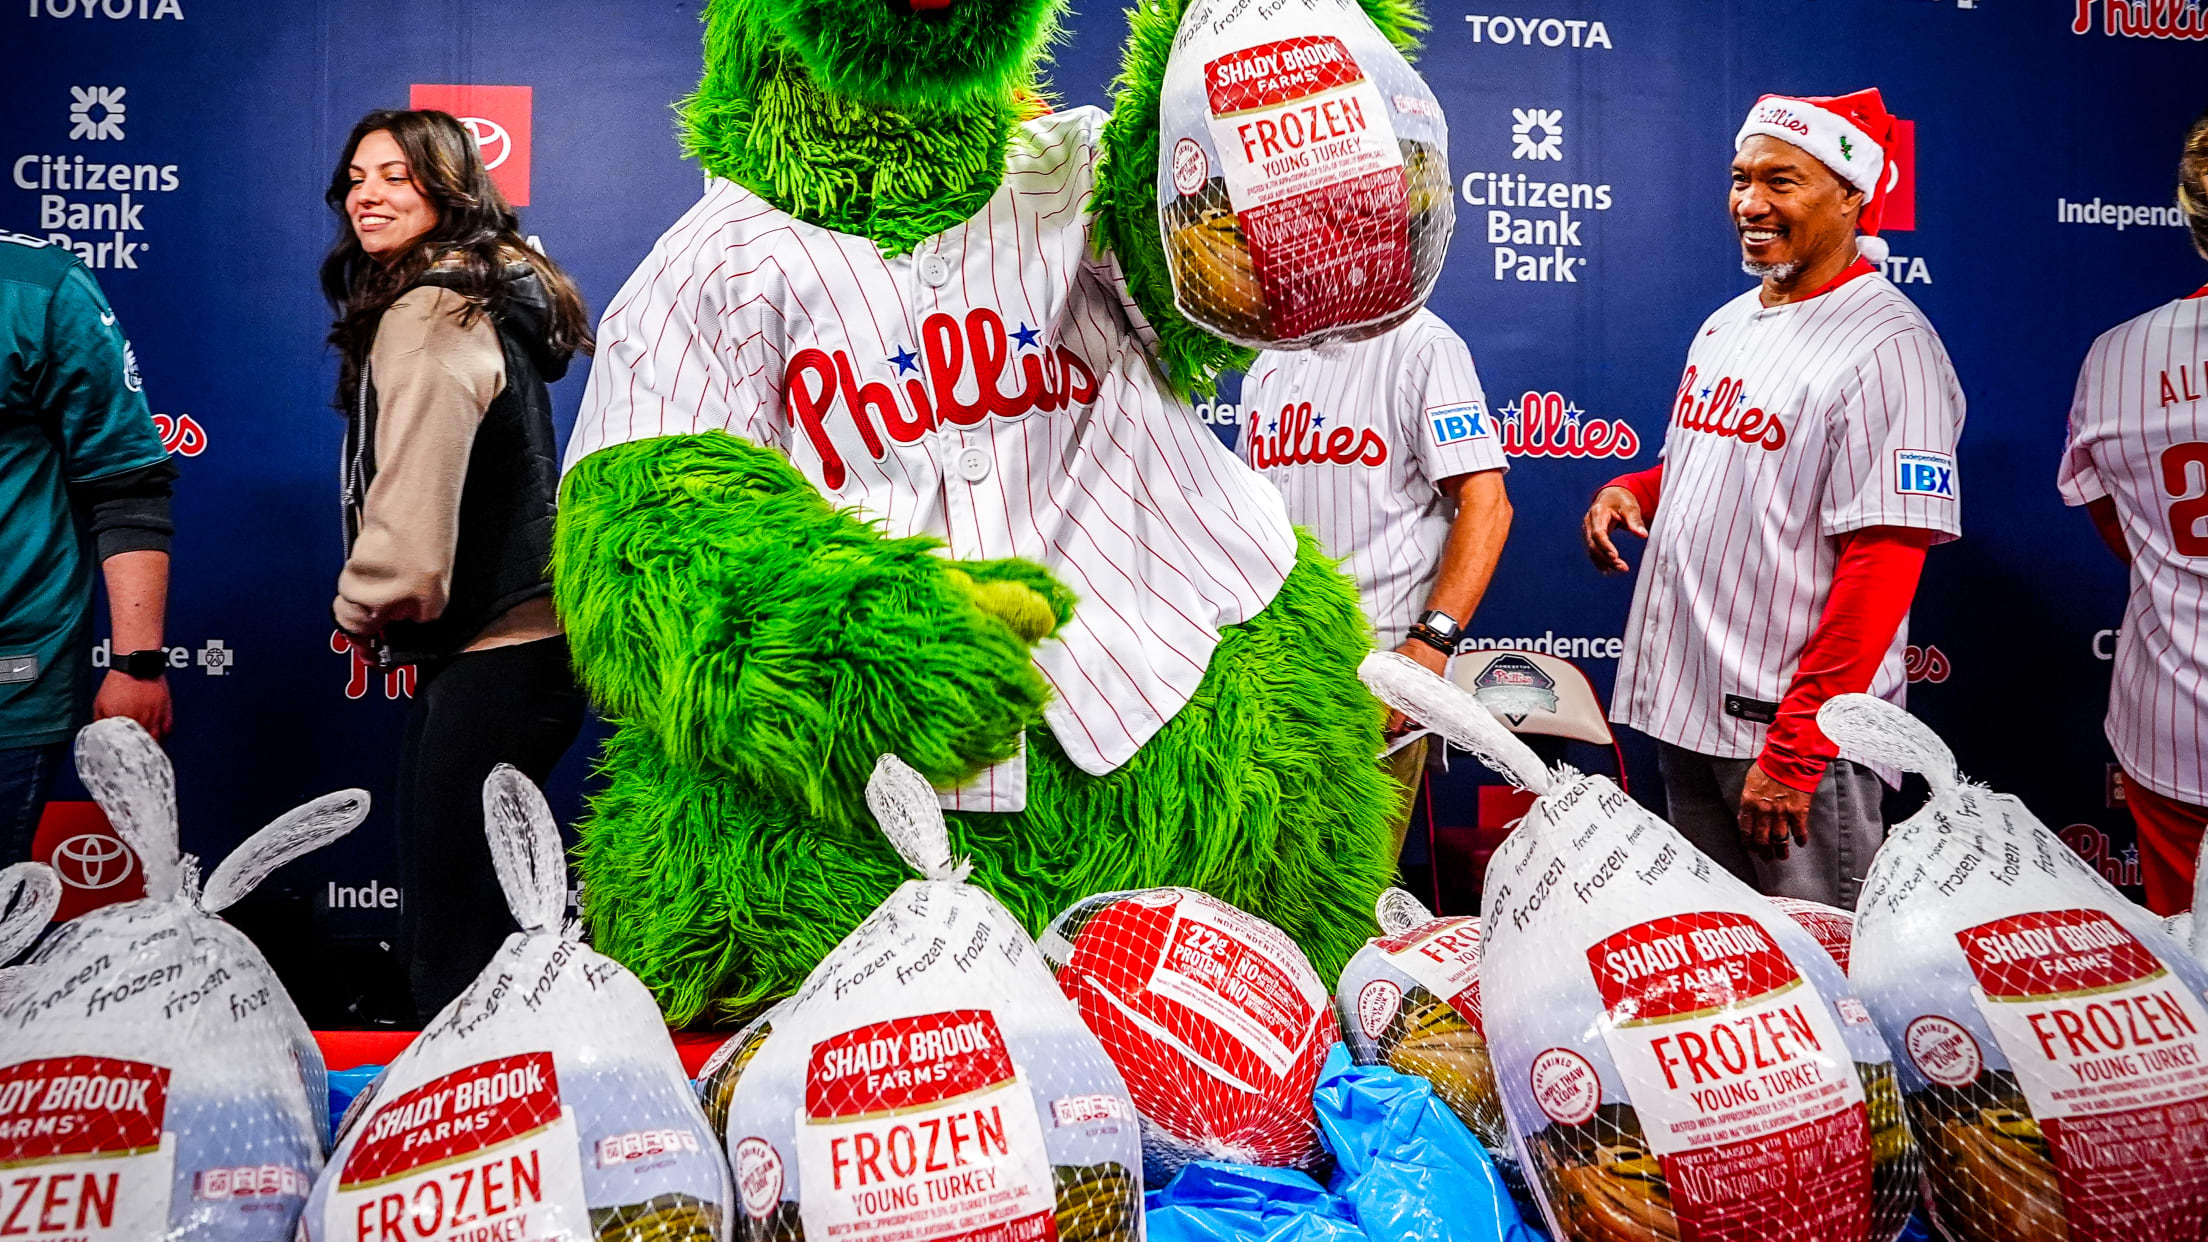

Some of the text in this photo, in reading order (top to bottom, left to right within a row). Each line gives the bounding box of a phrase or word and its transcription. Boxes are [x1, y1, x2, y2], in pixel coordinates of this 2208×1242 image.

[1465, 15, 1613, 49] TOYOTA
[1216, 43, 1344, 87] SHADY BROOK
[1257, 70, 1316, 93] FARMS
[1237, 96, 1367, 164] FROZEN
[13, 155, 180, 191] Citizens
[1262, 136, 1362, 179] YOUNG TURKEY
[41, 193, 144, 231] Bank
[1461, 172, 1612, 210] Citizens
[1487, 210, 1581, 246] Bank
[1494, 247, 1577, 282] Park
[1433, 412, 1486, 442] IBX
[1901, 463, 1953, 496] IBX
[1573, 822, 1598, 852] frozen
[1574, 846, 1629, 905] frozen
[1636, 842, 1678, 886] frozen
[1935, 852, 1981, 898] frozen
[1513, 856, 1567, 933] frozen
[897, 935, 947, 986] frozen
[953, 921, 992, 974] frozen
[1185, 924, 1229, 956] 22g
[1606, 934, 1693, 983] SHADY
[1691, 925, 1770, 962] BROOK
[1977, 918, 2131, 965] SHADY BROOK
[522, 939, 577, 1013] frozen
[833, 948, 897, 1001] frozen
[1173, 944, 1227, 980] PROTEIN
[1237, 957, 1260, 981] NO
[1668, 962, 1744, 993] FARMS
[2039, 953, 2112, 977] FARMS
[85, 962, 184, 1020] frozen
[1225, 977, 1248, 1002] NO
[1650, 1004, 1822, 1091] FROZEN
[2026, 991, 2198, 1061] FROZEN
[823, 1021, 991, 1082] SHADY BROOK
[2069, 1055, 2138, 1085] YOUNG
[2138, 1043, 2201, 1075] TURKEY
[39, 1075, 152, 1112] BROOK
[867, 1063, 948, 1094] FARMS
[1691, 1061, 1824, 1114] YOUNG TURKEY
[367, 1064, 544, 1145] SHADY BROOK
[403, 1110, 491, 1152] FARMS
[831, 1106, 1009, 1191] FROZEN
[0, 1172, 120, 1237] ZEN
[357, 1149, 542, 1242] FROZEN
[852, 1167, 997, 1217] YOUNG TURKEY
[1679, 1166, 1714, 1207] NO
